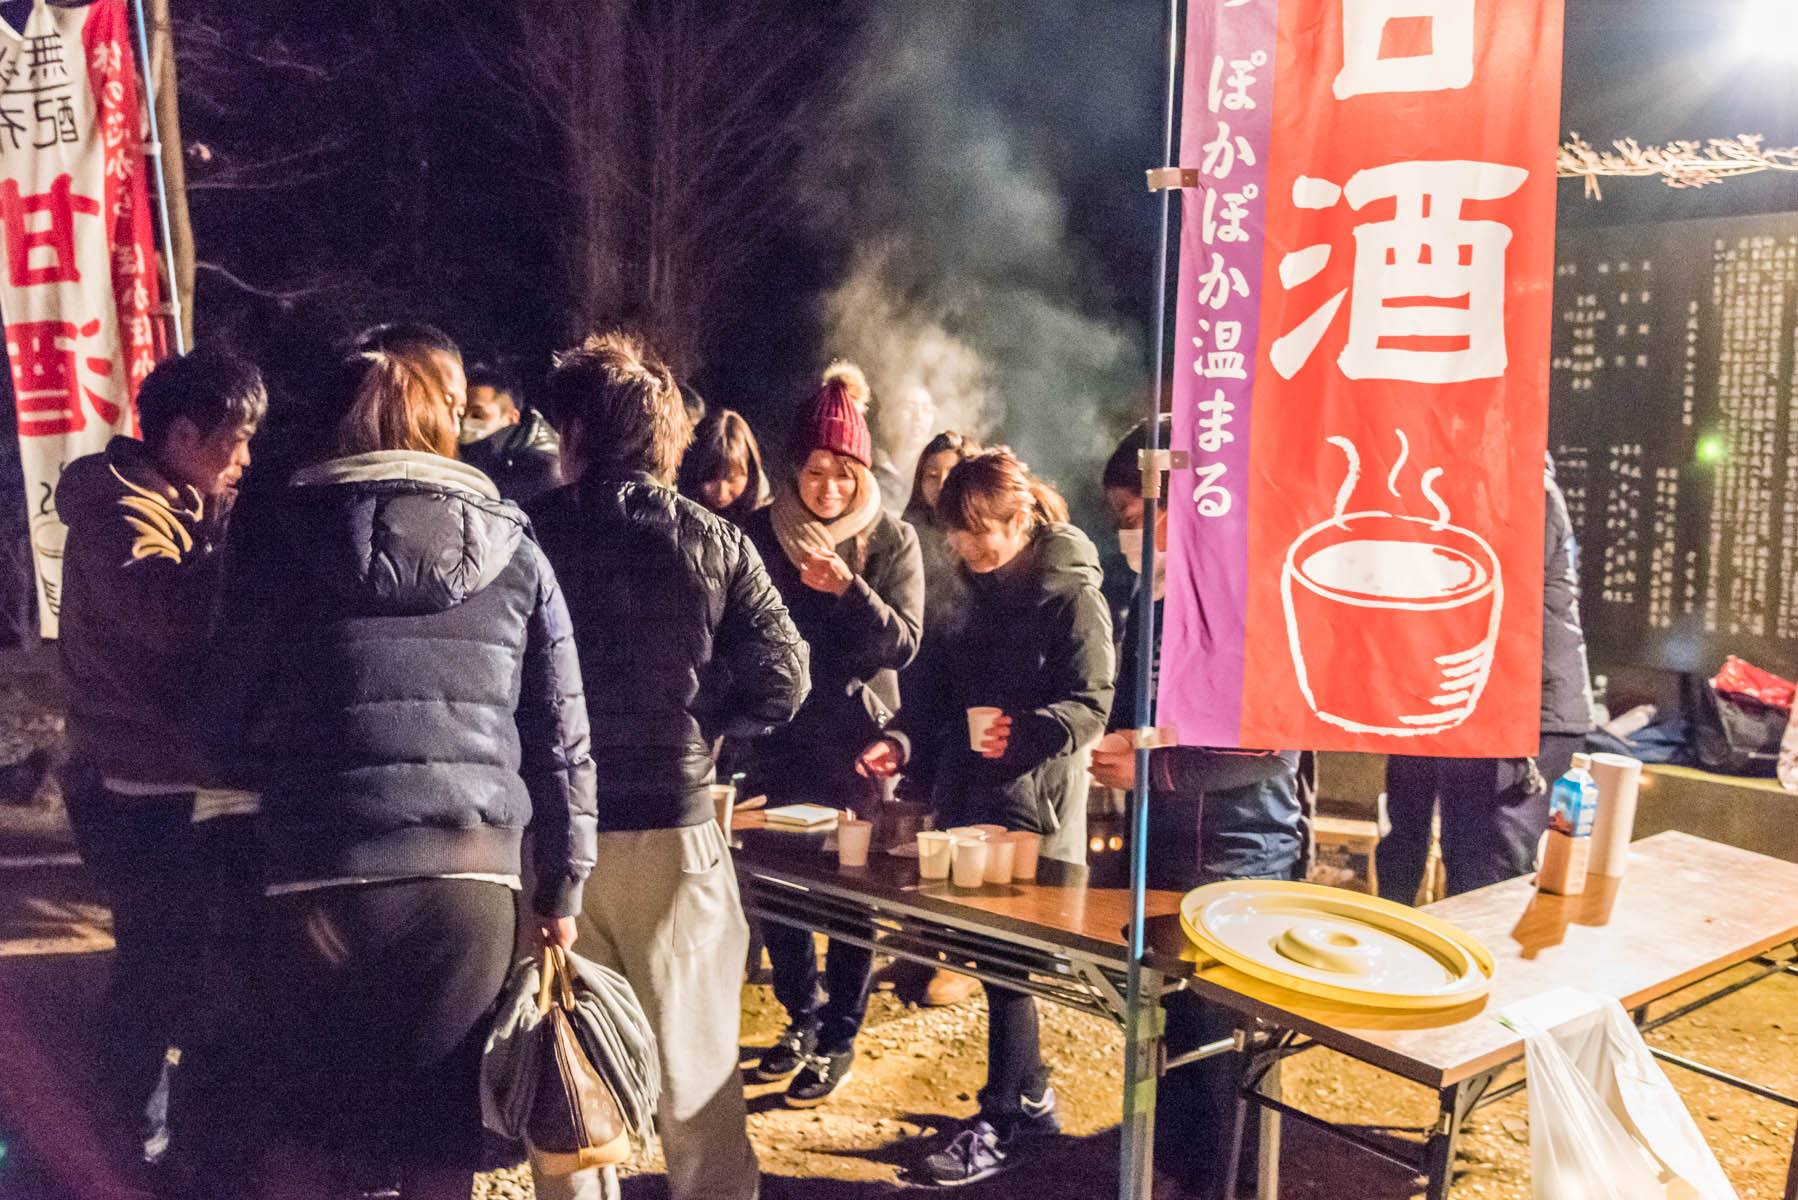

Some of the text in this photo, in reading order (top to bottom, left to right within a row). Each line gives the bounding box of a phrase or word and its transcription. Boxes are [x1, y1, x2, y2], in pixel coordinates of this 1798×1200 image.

[1192, 50, 1267, 518] ぽかぽか温まる
